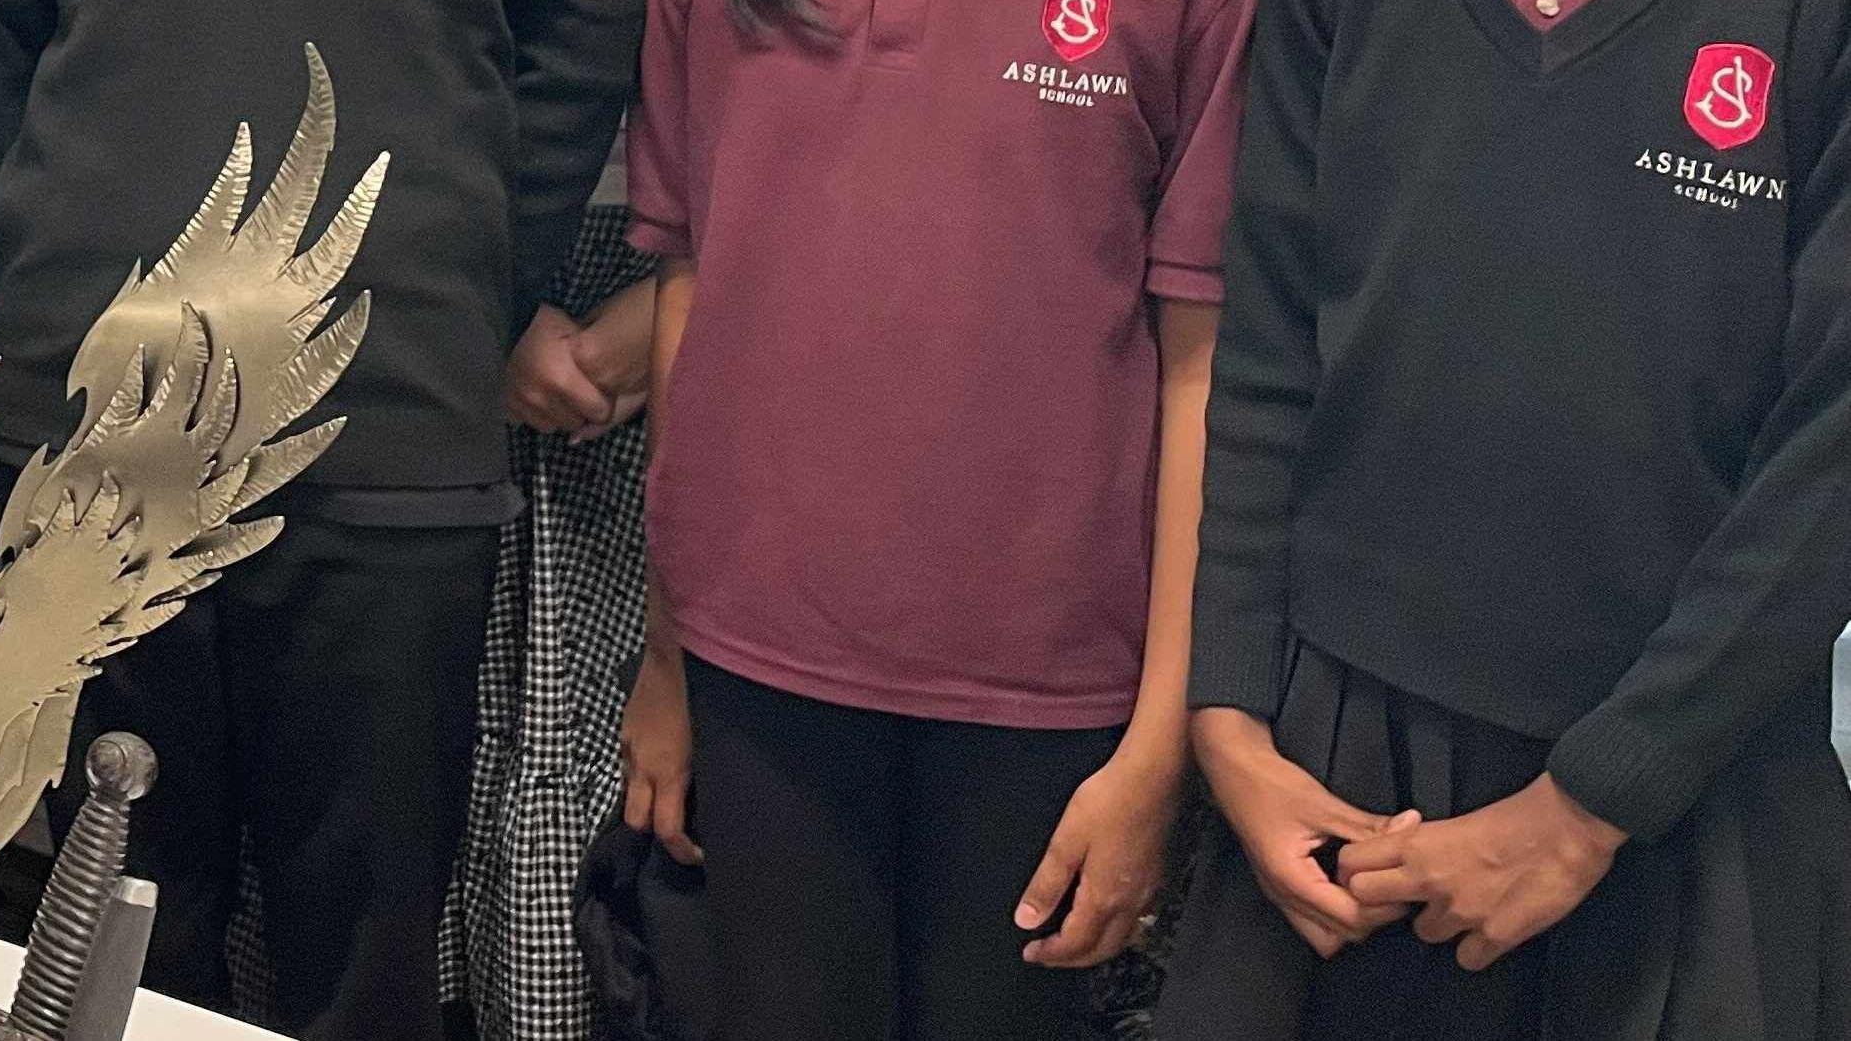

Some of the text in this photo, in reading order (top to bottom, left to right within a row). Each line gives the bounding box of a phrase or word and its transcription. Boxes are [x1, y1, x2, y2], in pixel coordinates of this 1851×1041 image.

[1002, 61, 1128, 95] ASHLAWN
[1039, 88, 1095, 107] SCHOOL
[1634, 148, 1788, 200] ASHLAWN
[1674, 184, 1739, 209] SCHOOL
